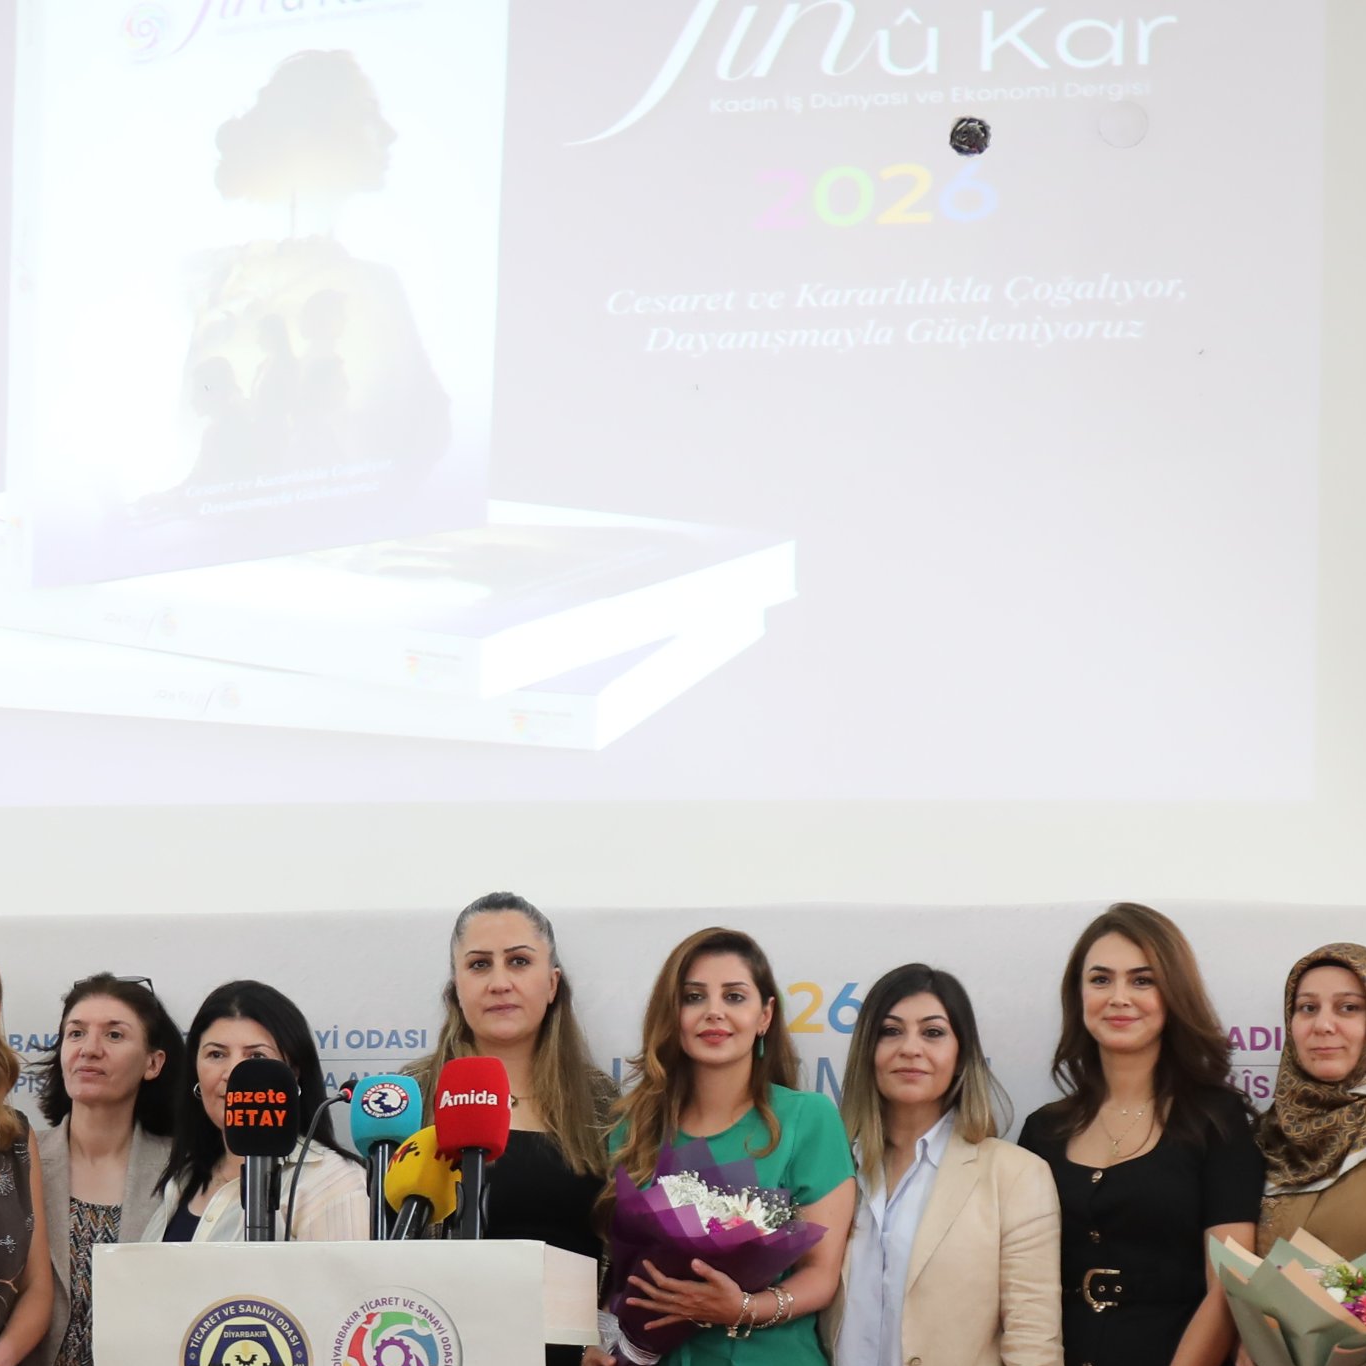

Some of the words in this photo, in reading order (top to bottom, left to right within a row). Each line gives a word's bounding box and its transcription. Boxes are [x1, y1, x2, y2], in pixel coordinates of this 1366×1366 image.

[875, 13, 938, 77] û
[980, 5, 1179, 72] Kar
[709, 94, 778, 114] Kadın
[811, 90, 908, 113] Dünyası
[915, 89, 944, 105] ve
[951, 84, 1057, 105] Ekonomi
[1064, 79, 1152, 101] Dergisi
[754, 160, 999, 230] 2026
[605, 287, 736, 316] Cesaret
[747, 290, 785, 311] ve
[794, 277, 993, 310] Kararlılıkla
[1004, 271, 1188, 312] Çoğalıyor,
[644, 316, 895, 360] Dayanışmayla
[906, 313, 1148, 352] Güçleniyoruz
[787, 981, 864, 1034] 26
[345, 1029, 427, 1049] ODASI
[226, 1088, 287, 1107] gazete
[439, 1089, 498, 1109] Amida
[226, 1109, 287, 1127] DETAY
[190, 1312, 221, 1348] TİCARET
[222, 1305, 236, 1316] VE
[239, 1304, 278, 1320] SANAYİ
[277, 1317, 301, 1346] ODASI
[223, 1330, 268, 1338] DİYARBAKIR
[360, 1297, 400, 1314] TİCARET
[403, 1298, 415, 1310] VE
[416, 1304, 449, 1336] SANAYİ
